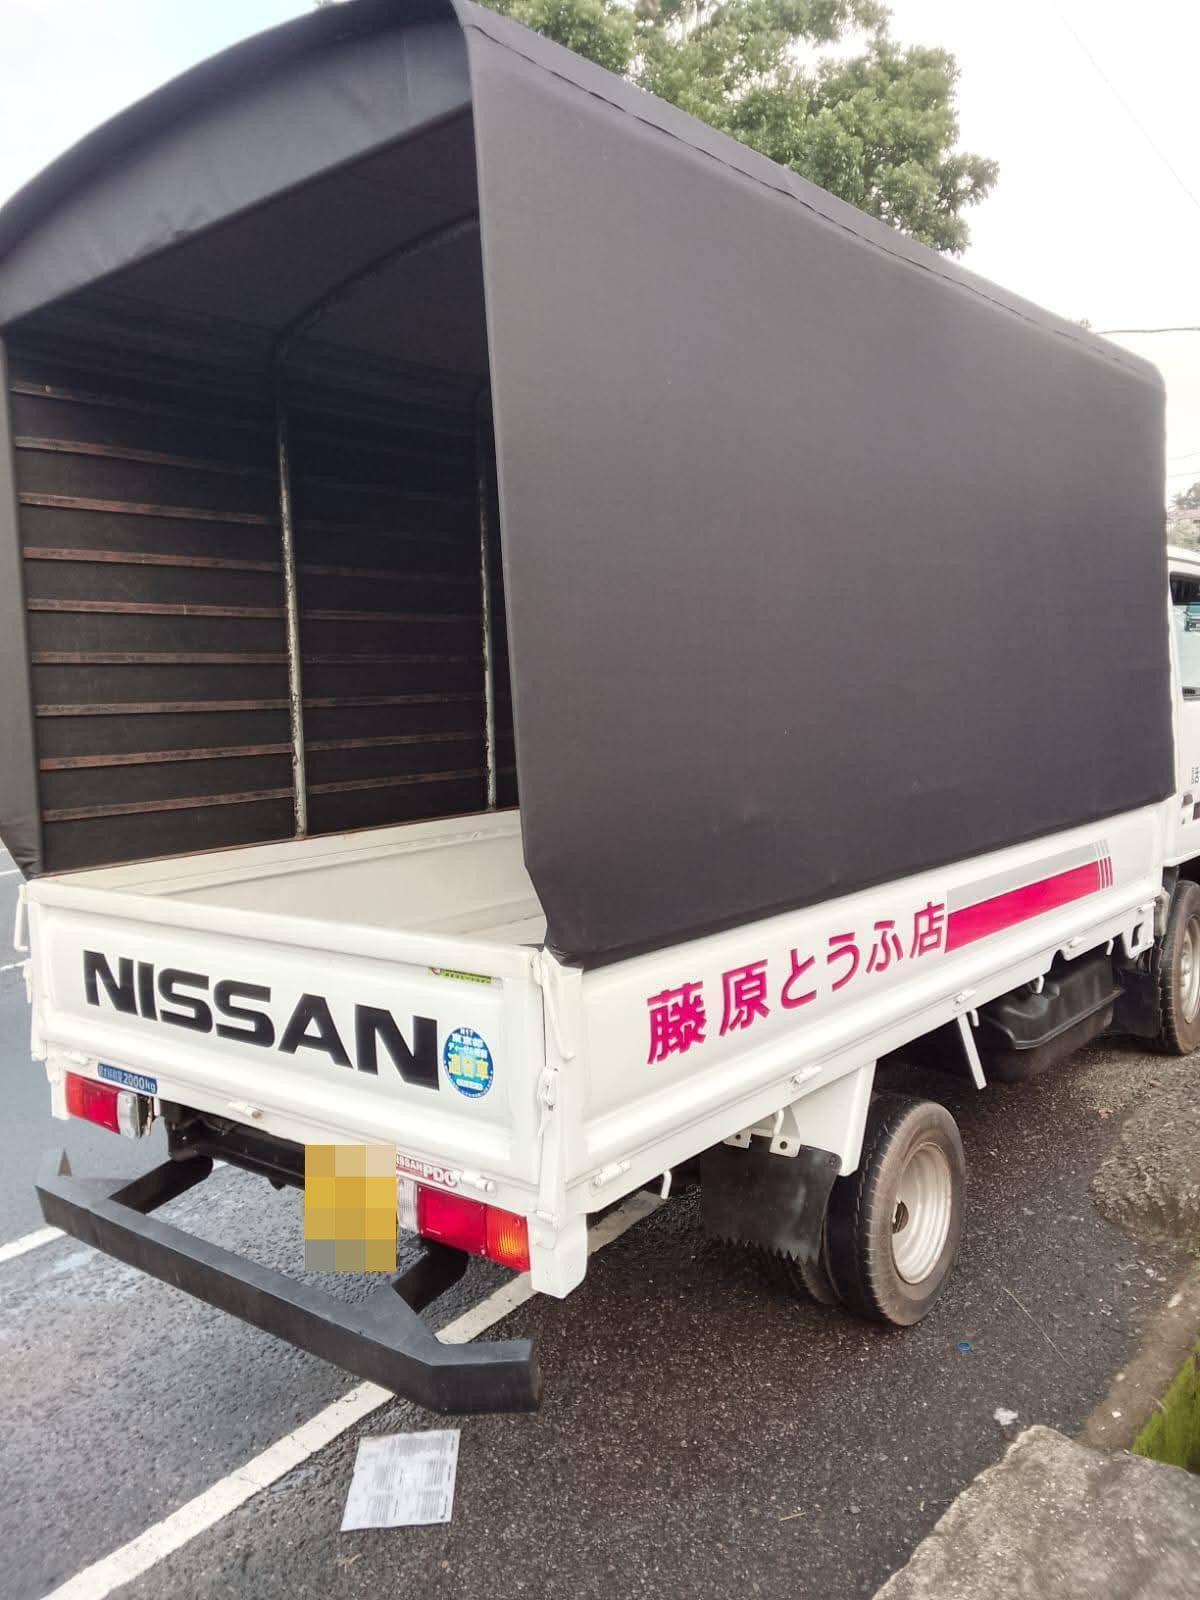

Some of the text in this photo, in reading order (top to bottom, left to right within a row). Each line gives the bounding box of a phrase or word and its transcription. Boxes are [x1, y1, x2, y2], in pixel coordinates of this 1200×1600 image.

[84, 950, 440, 1091] NISSAN
[646, 901, 945, 1065] 藤原とうふ店
[396, 1154, 423, 1172] ISSAN
